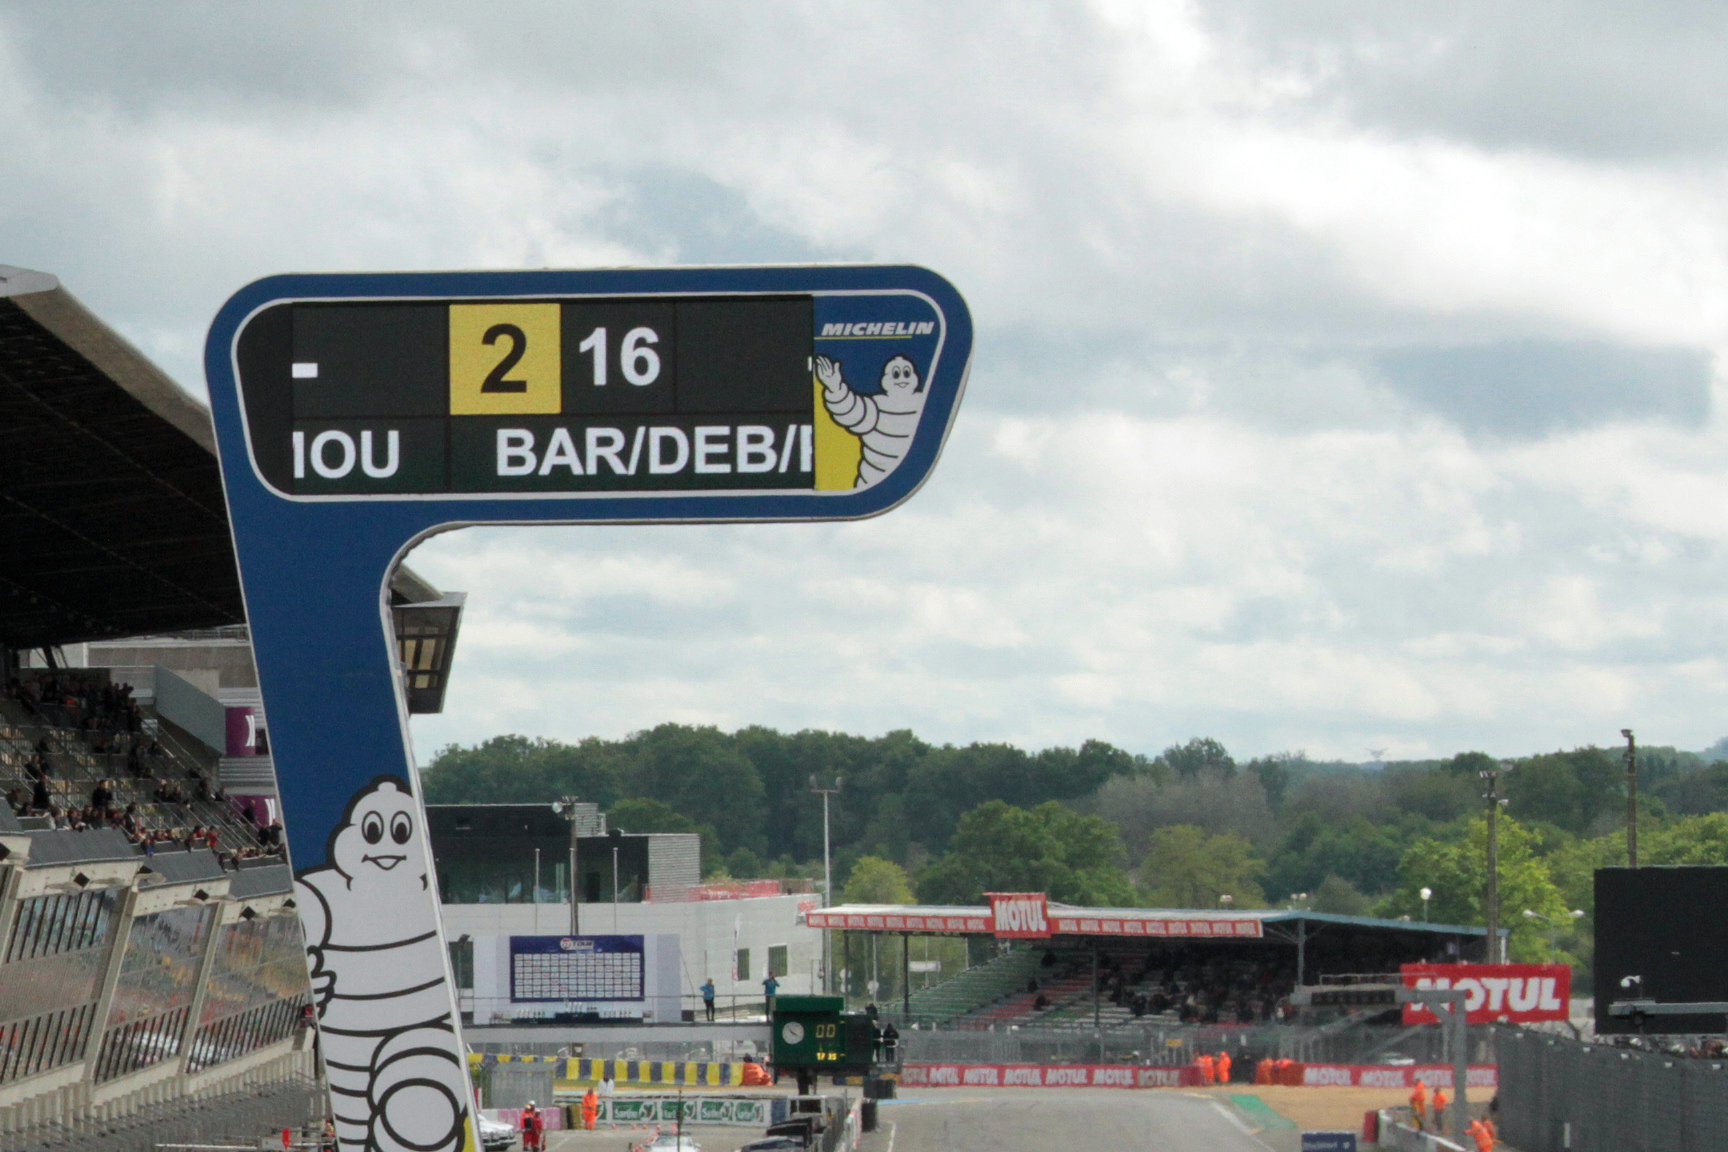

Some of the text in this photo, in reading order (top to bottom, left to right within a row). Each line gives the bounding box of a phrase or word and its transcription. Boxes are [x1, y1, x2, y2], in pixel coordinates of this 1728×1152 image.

[821, 321, 935, 336] MICHELIN
[480, 323, 527, 394] 2
[579, 326, 661, 386] 16
[995, 899, 1047, 932] MOTUL
